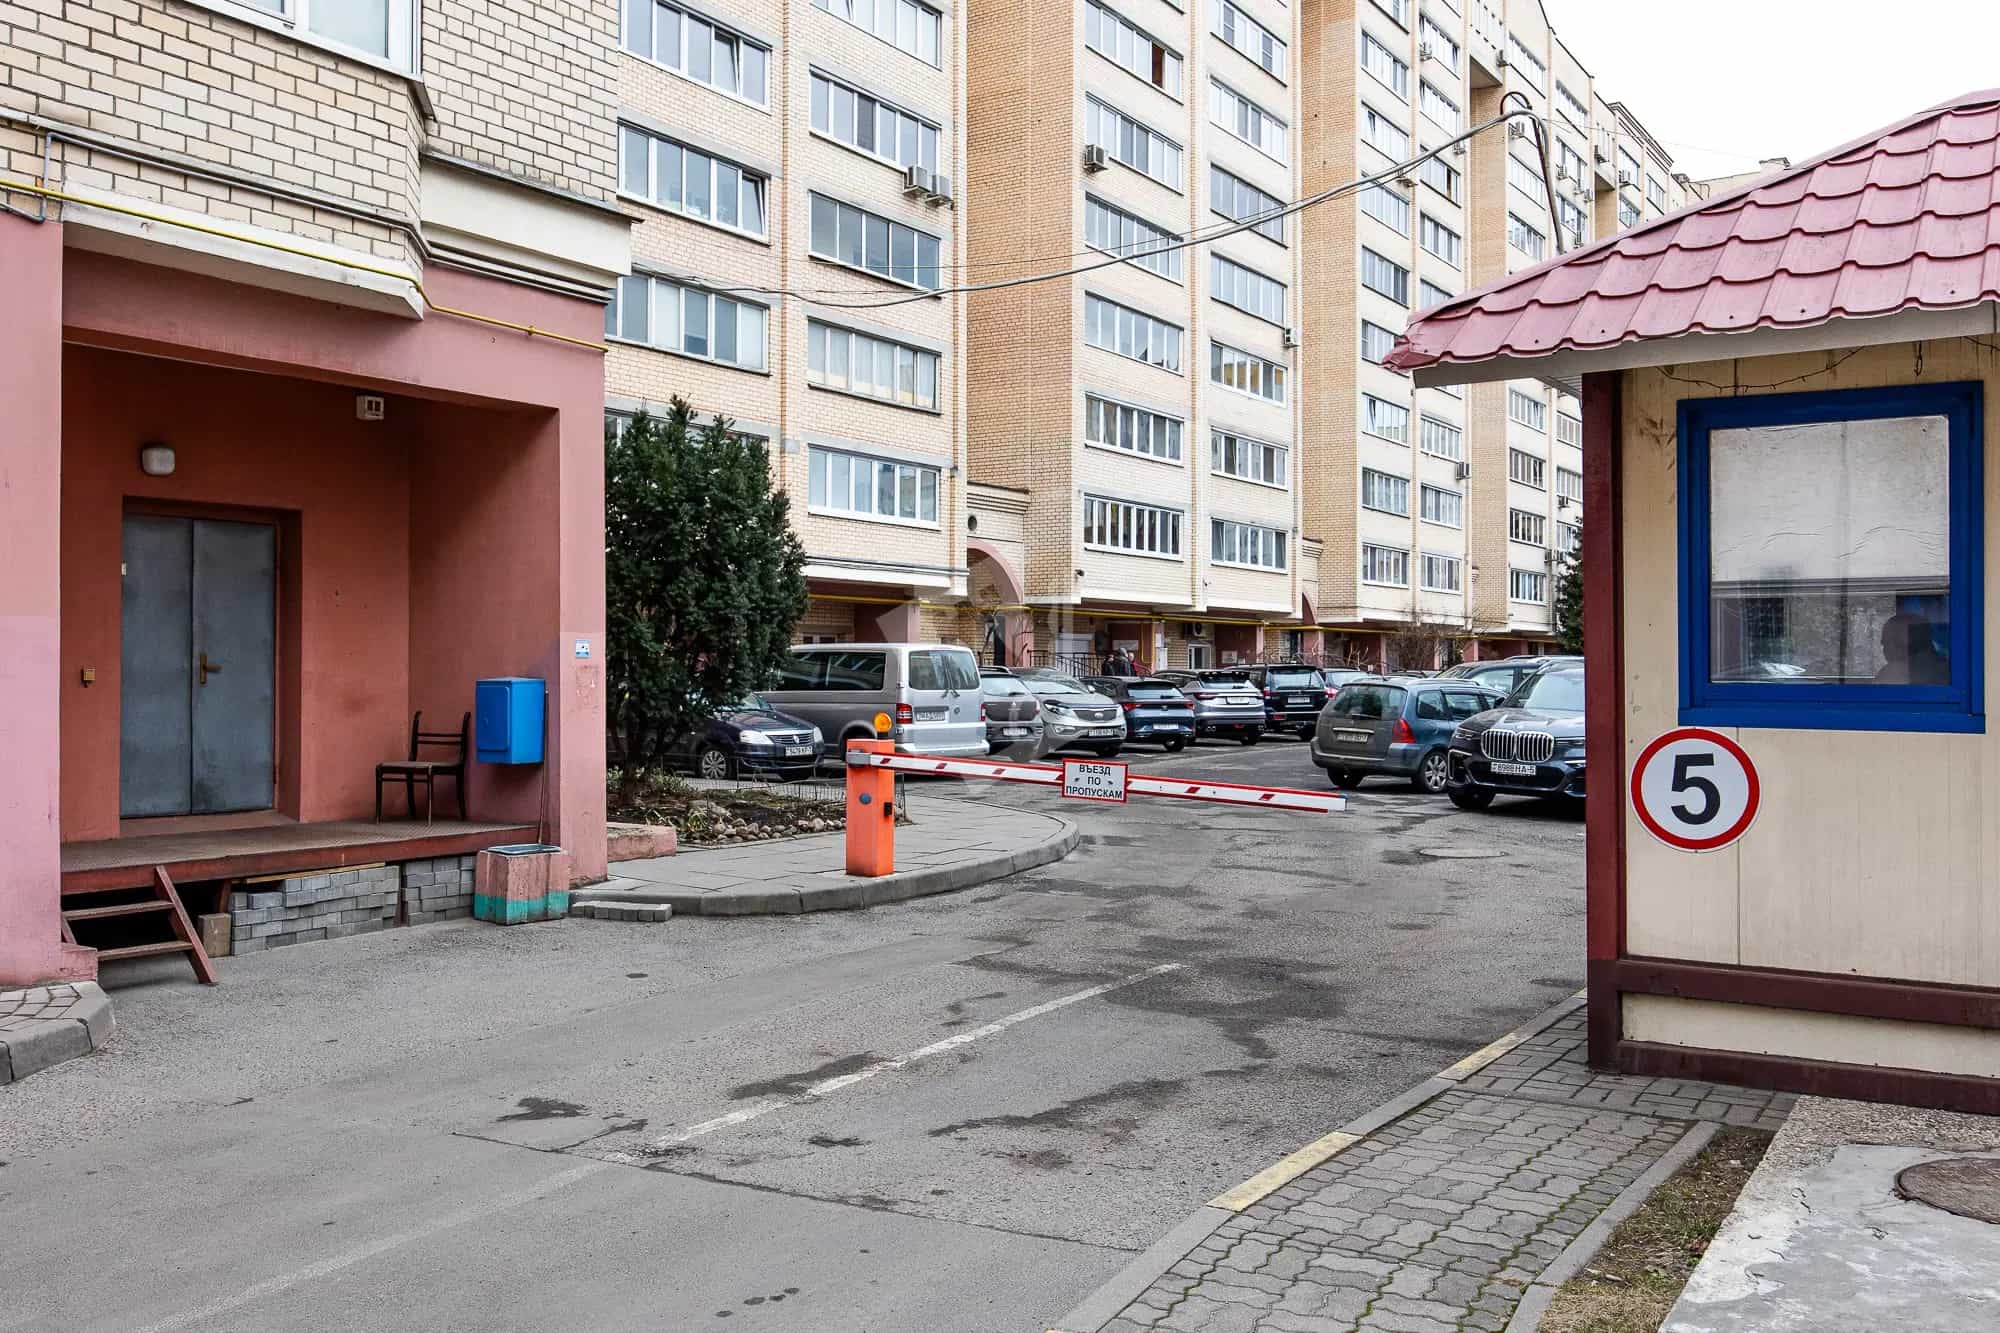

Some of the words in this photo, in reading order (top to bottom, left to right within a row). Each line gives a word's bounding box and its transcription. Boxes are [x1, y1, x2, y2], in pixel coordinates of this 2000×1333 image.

[1079, 764, 1111, 776] ВЪЕЗД
[1087, 776, 1101, 786] ПО
[1066, 785, 1123, 799] ПРОПУСКАМ
[1671, 753, 1721, 825] 5
